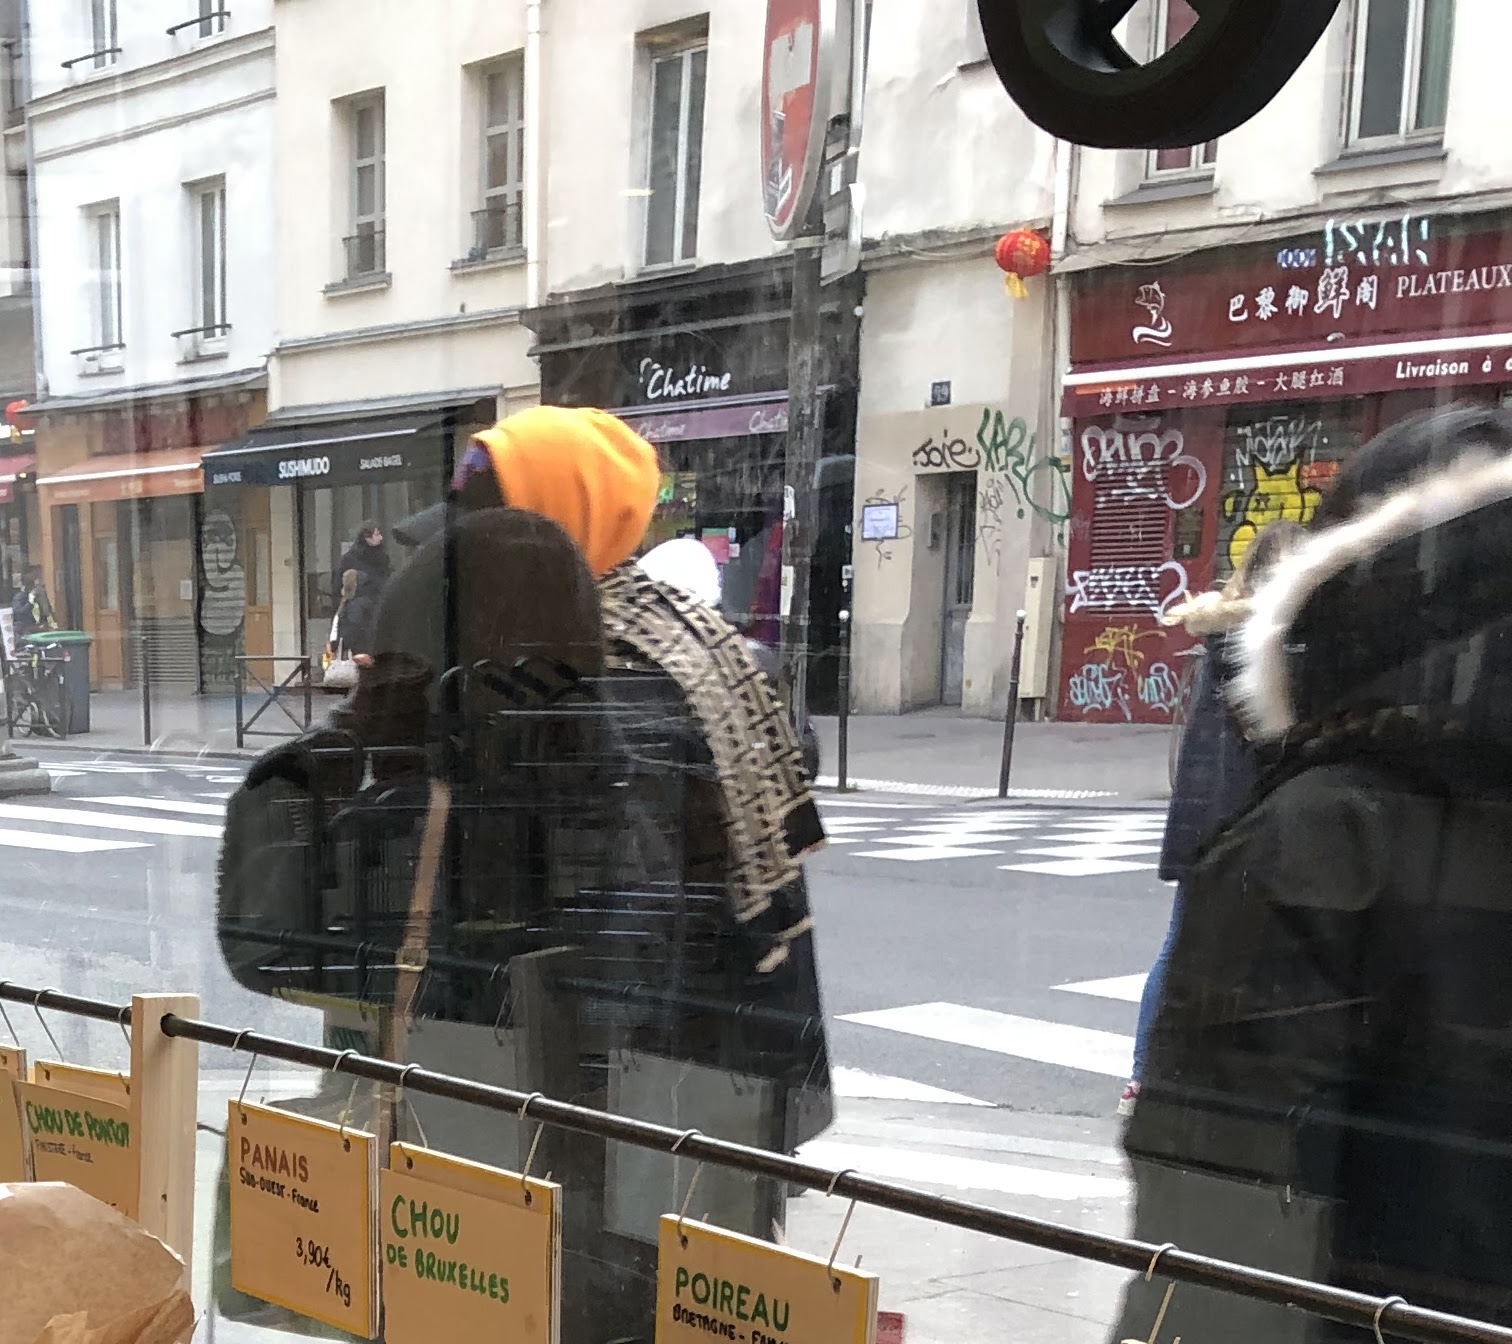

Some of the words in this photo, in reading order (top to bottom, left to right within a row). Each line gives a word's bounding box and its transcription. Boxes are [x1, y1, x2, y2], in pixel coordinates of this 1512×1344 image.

[1396, 264, 1512, 298] PLATEAUX
[647, 364, 732, 399] Chatime
[1396, 358, 1469, 379] Livraison
[749, 410, 789, 433] Chati
[25, 1100, 63, 1135] CHOU
[64, 1109, 85, 1138] DE
[240, 1136, 310, 1184] PANAIS
[391, 1194, 460, 1246] CHOU
[386, 1243, 408, 1269] DE
[414, 1247, 511, 1304] BRUXELLES
[675, 1266, 790, 1332] POIREAU
[672, 1302, 736, 1341] BRETAGNE
